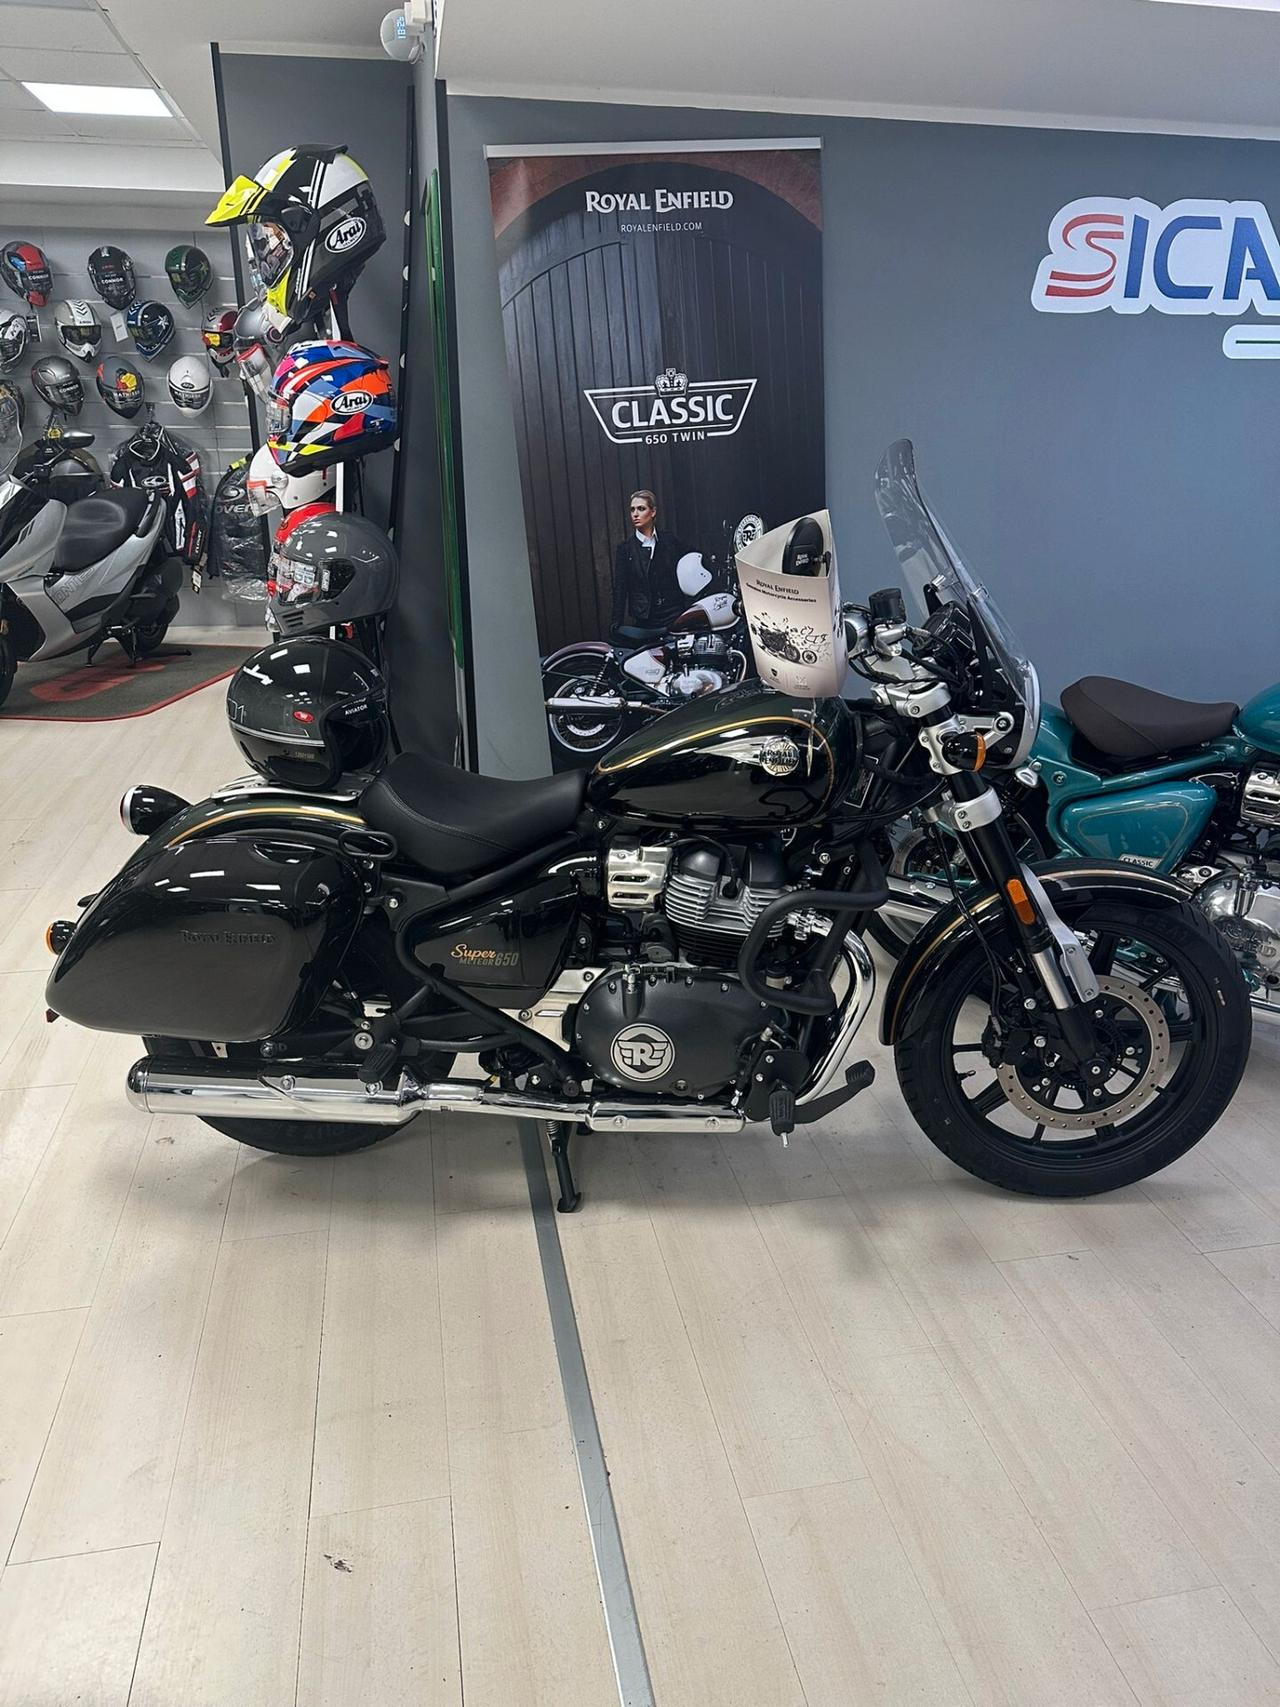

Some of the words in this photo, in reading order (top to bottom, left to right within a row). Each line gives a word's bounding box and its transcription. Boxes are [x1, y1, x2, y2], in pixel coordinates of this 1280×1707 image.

[586, 191, 651, 213] ROYAL
[655, 189, 734, 213] ENFIELD
[331, 220, 362, 249] Arai
[620, 222, 703, 232] ROYALENFIELD.COM
[101, 277, 124, 285] CONNOR
[335, 395, 368, 412] Arai
[611, 394, 734, 428] CLASSIC
[645, 433, 668, 445] 650
[672, 430, 706, 443] TWIN
[756, 579, 774, 591] ROYAL
[774, 584, 800, 595] ENFIELD
[345, 704, 368, 716] AVIATOR
[450, 943, 497, 960] Super
[495, 952, 519, 967] 650
